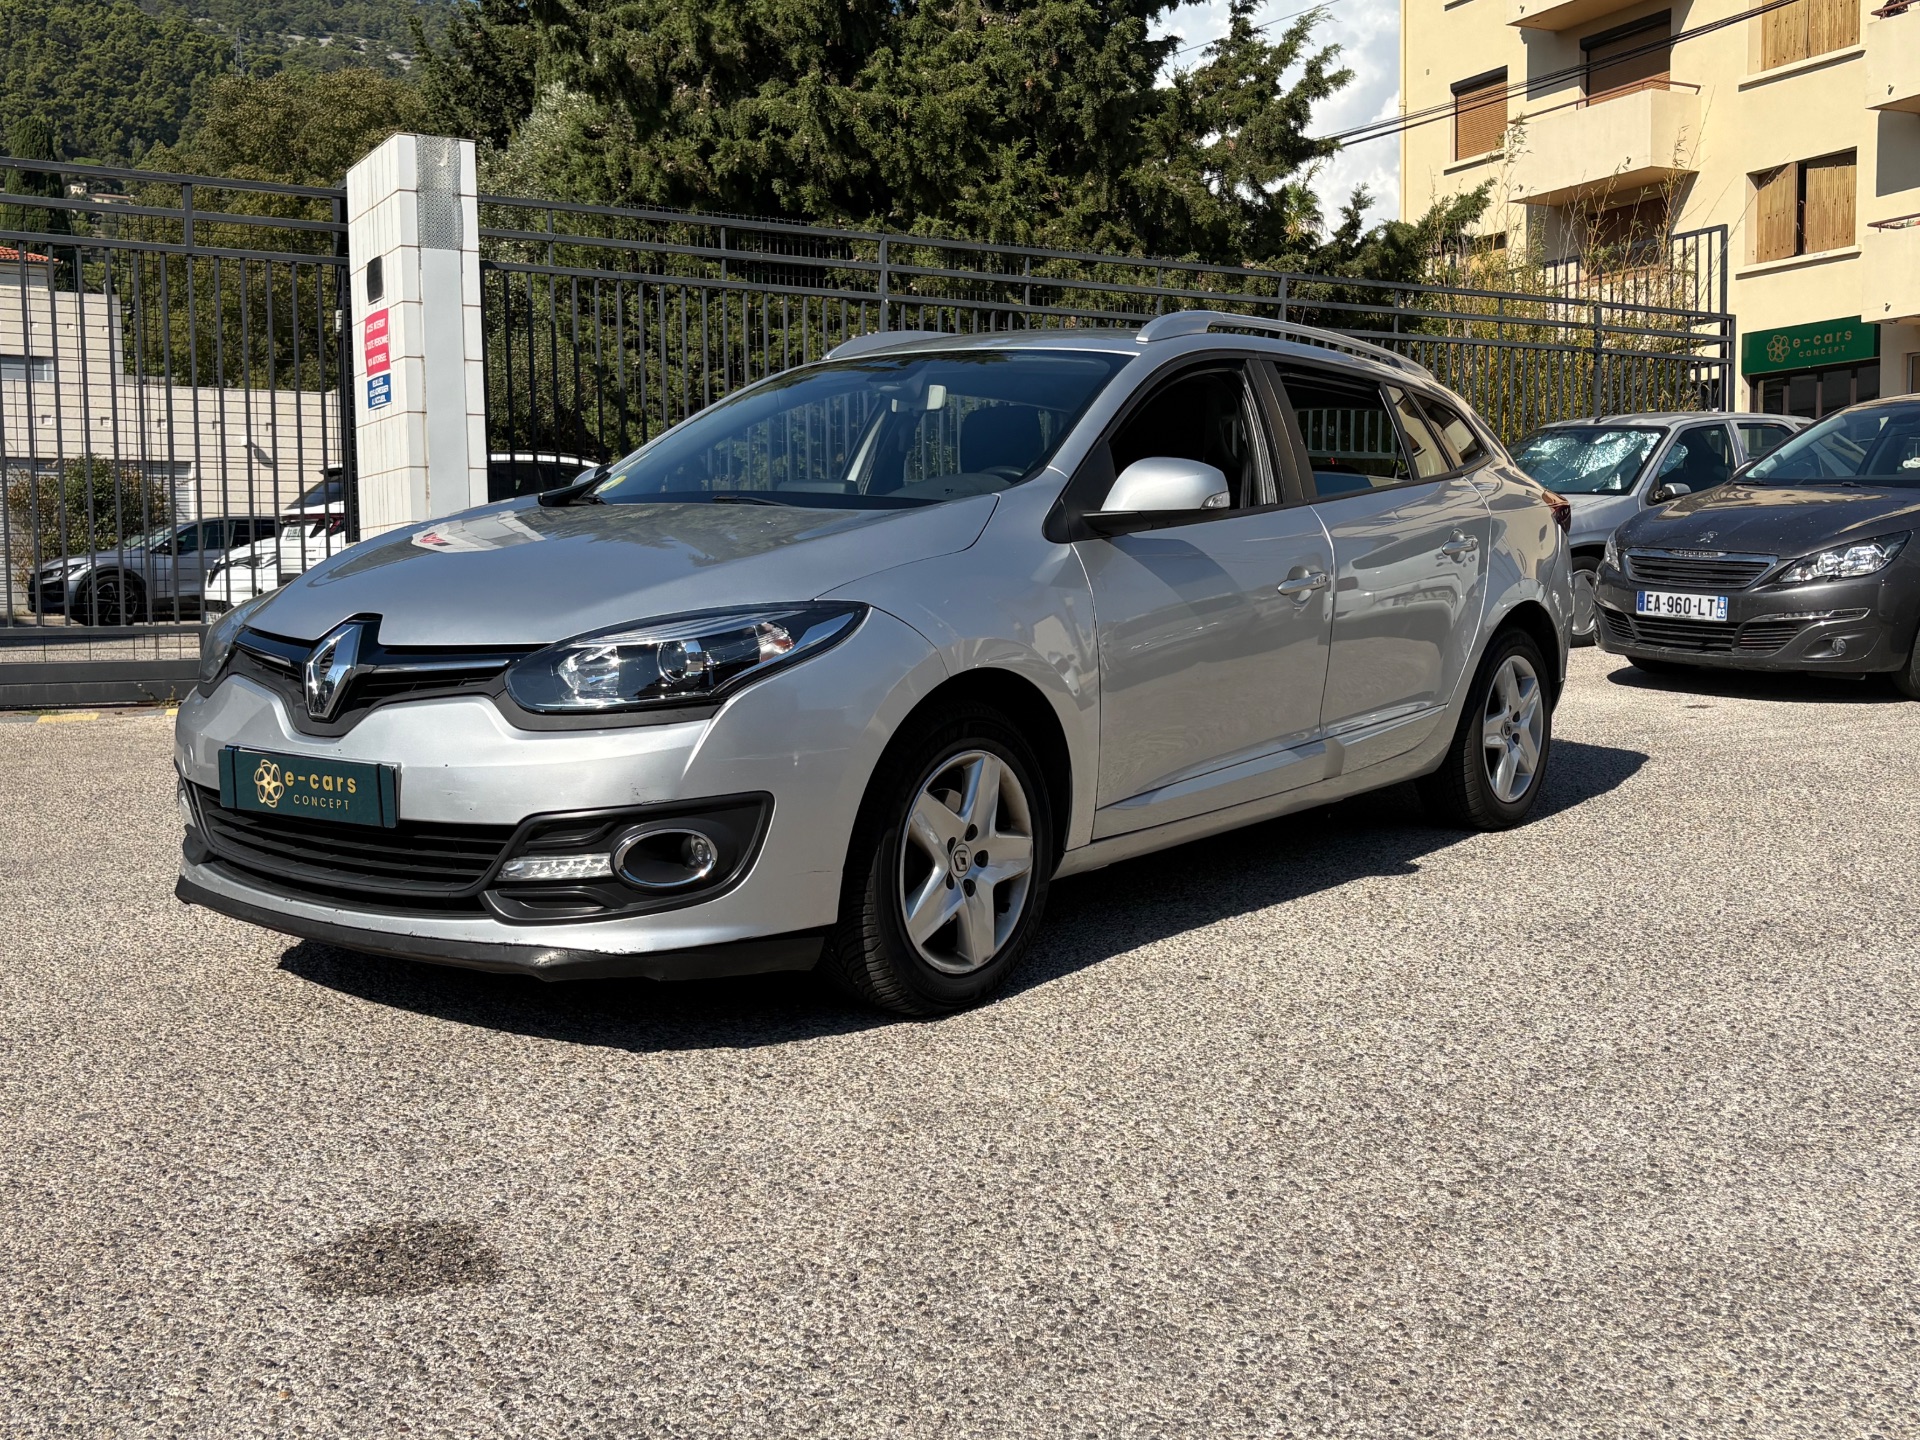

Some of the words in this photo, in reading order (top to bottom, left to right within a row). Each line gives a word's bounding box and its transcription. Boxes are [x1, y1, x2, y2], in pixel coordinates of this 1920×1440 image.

[1793, 330, 1852, 348] e-cars
[1798, 345, 1845, 358] CONCEPT
[1646, 594, 1715, 616] EA-960-LT
[1717, 608, 1725, 617] 83
[285, 771, 357, 794] e-cars
[294, 794, 349, 810] CONCEPT
